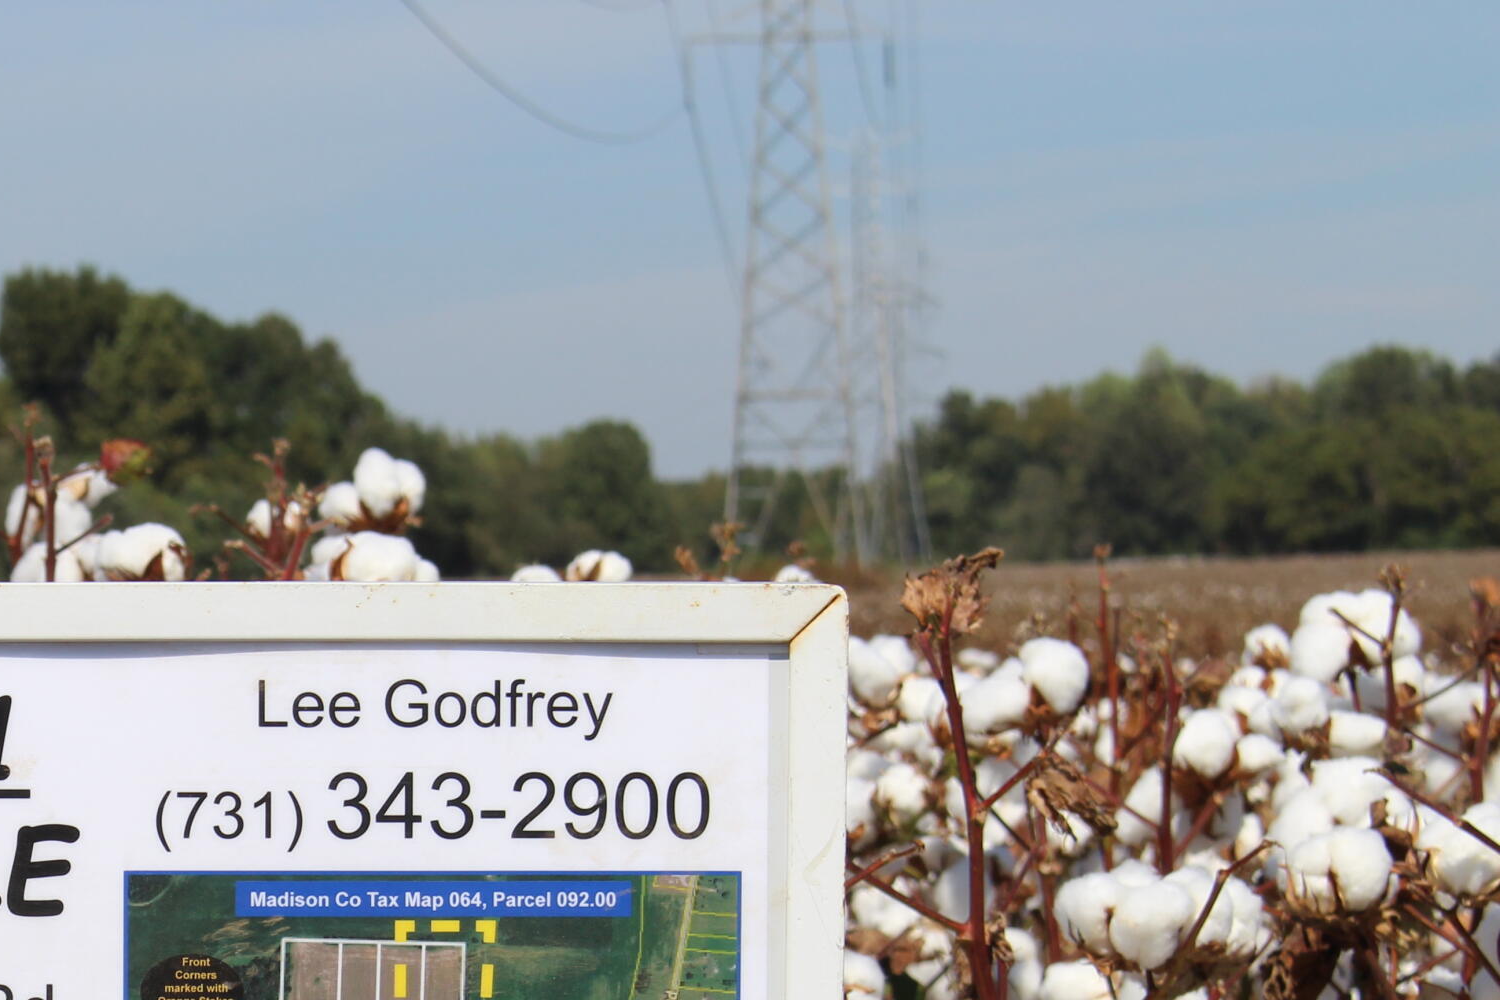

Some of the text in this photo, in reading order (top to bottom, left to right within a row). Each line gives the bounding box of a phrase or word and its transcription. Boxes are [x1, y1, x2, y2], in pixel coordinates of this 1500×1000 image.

[256, 679, 613, 741] Lee Godfrey
[154, 771, 712, 853] (731) 343-2900
[249, 891, 617, 911] Madison Co Tax Map 064, Parcel 092.00
[182, 957, 211, 967] Front
[175, 970, 217, 980] Corners
[164, 983, 229, 993] marked with
